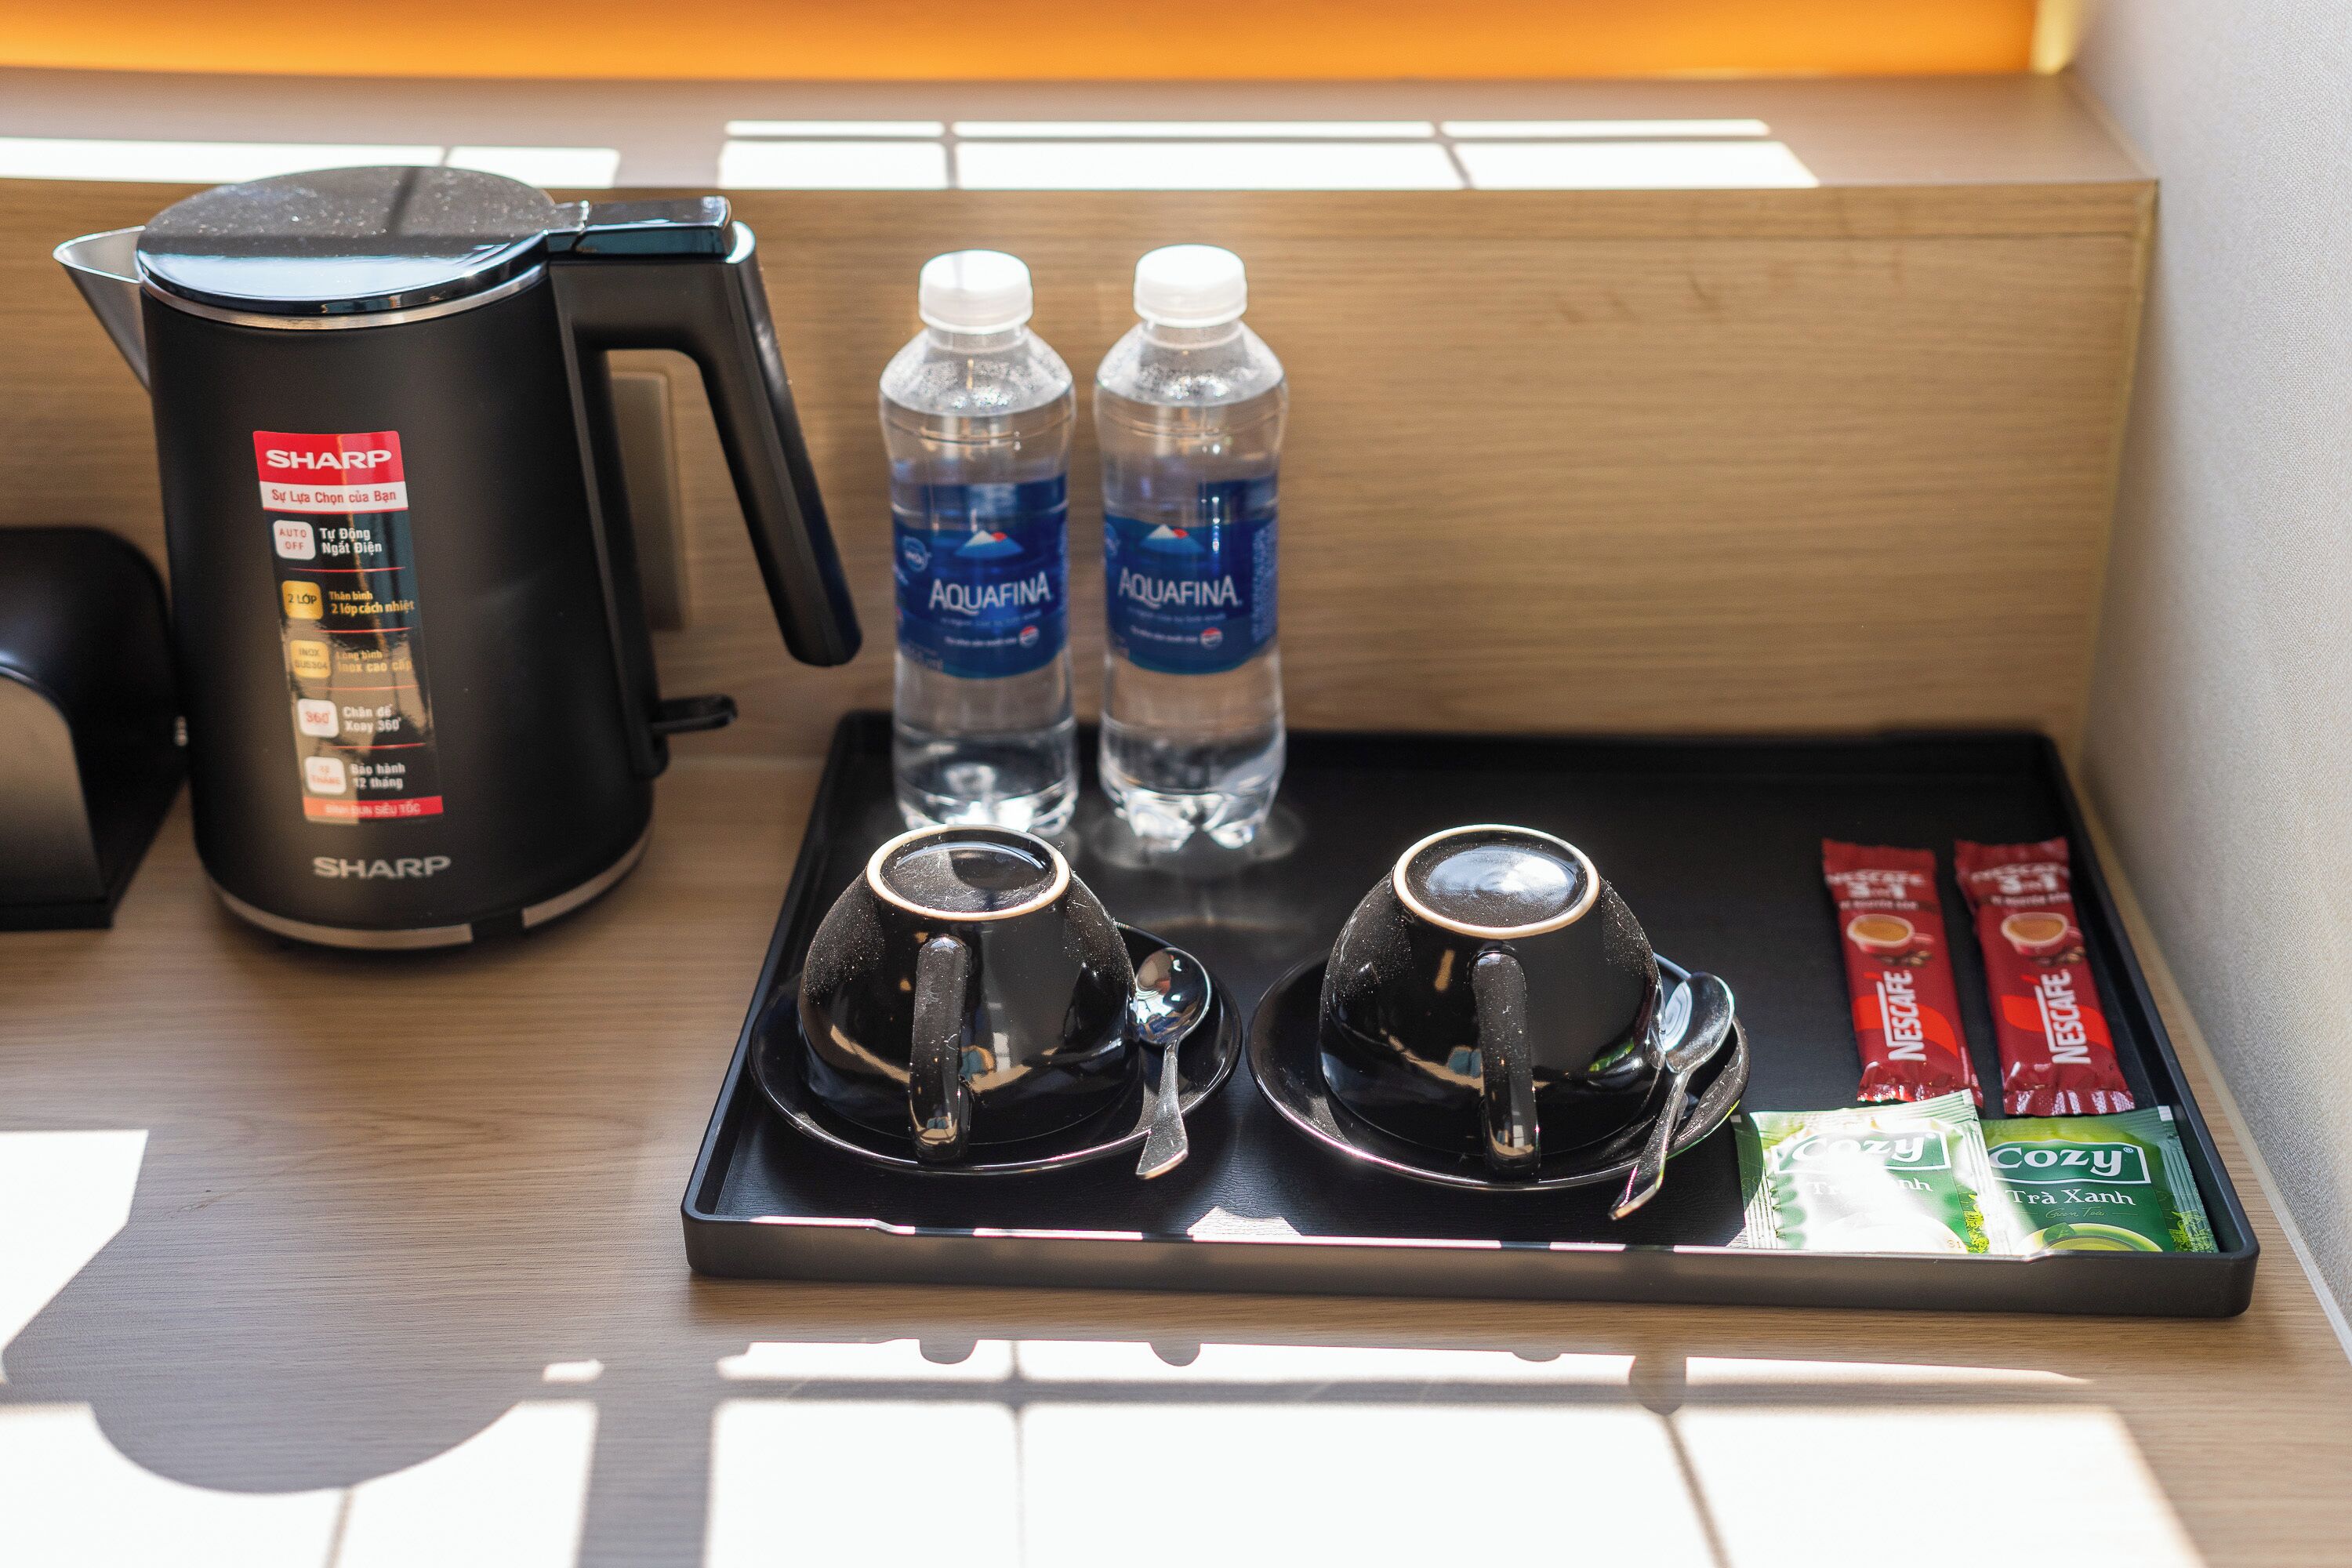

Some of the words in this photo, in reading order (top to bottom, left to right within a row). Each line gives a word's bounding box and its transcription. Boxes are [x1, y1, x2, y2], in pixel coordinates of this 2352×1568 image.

[265, 449, 392, 470] SHARP
[271, 488, 285, 503] Sự
[290, 490, 310, 503] Lựa
[314, 491, 344, 506] Chọn
[348, 489, 369, 503] của
[373, 490, 397, 504] Bạn
[279, 528, 307, 538] AUTO
[318, 527, 335, 542] Tự
[339, 527, 371, 543] Động
[285, 541, 304, 550] OFF
[321, 540, 350, 557] Ngắt
[354, 541, 383, 557] Điện
[928, 571, 1051, 616] AQUAFINA
[1117, 566, 1238, 610] AQUAFINA
[288, 593, 294, 604] 2
[296, 593, 318, 605] LỚP
[330, 603, 339, 615] 2
[313, 855, 452, 880] SHARP
[2005, 1189, 2058, 1205] Trà
[2061, 1189, 2136, 1206] Xanh
[2045, 1207, 2079, 1219] Green
[2082, 1206, 2106, 1218] Tea
